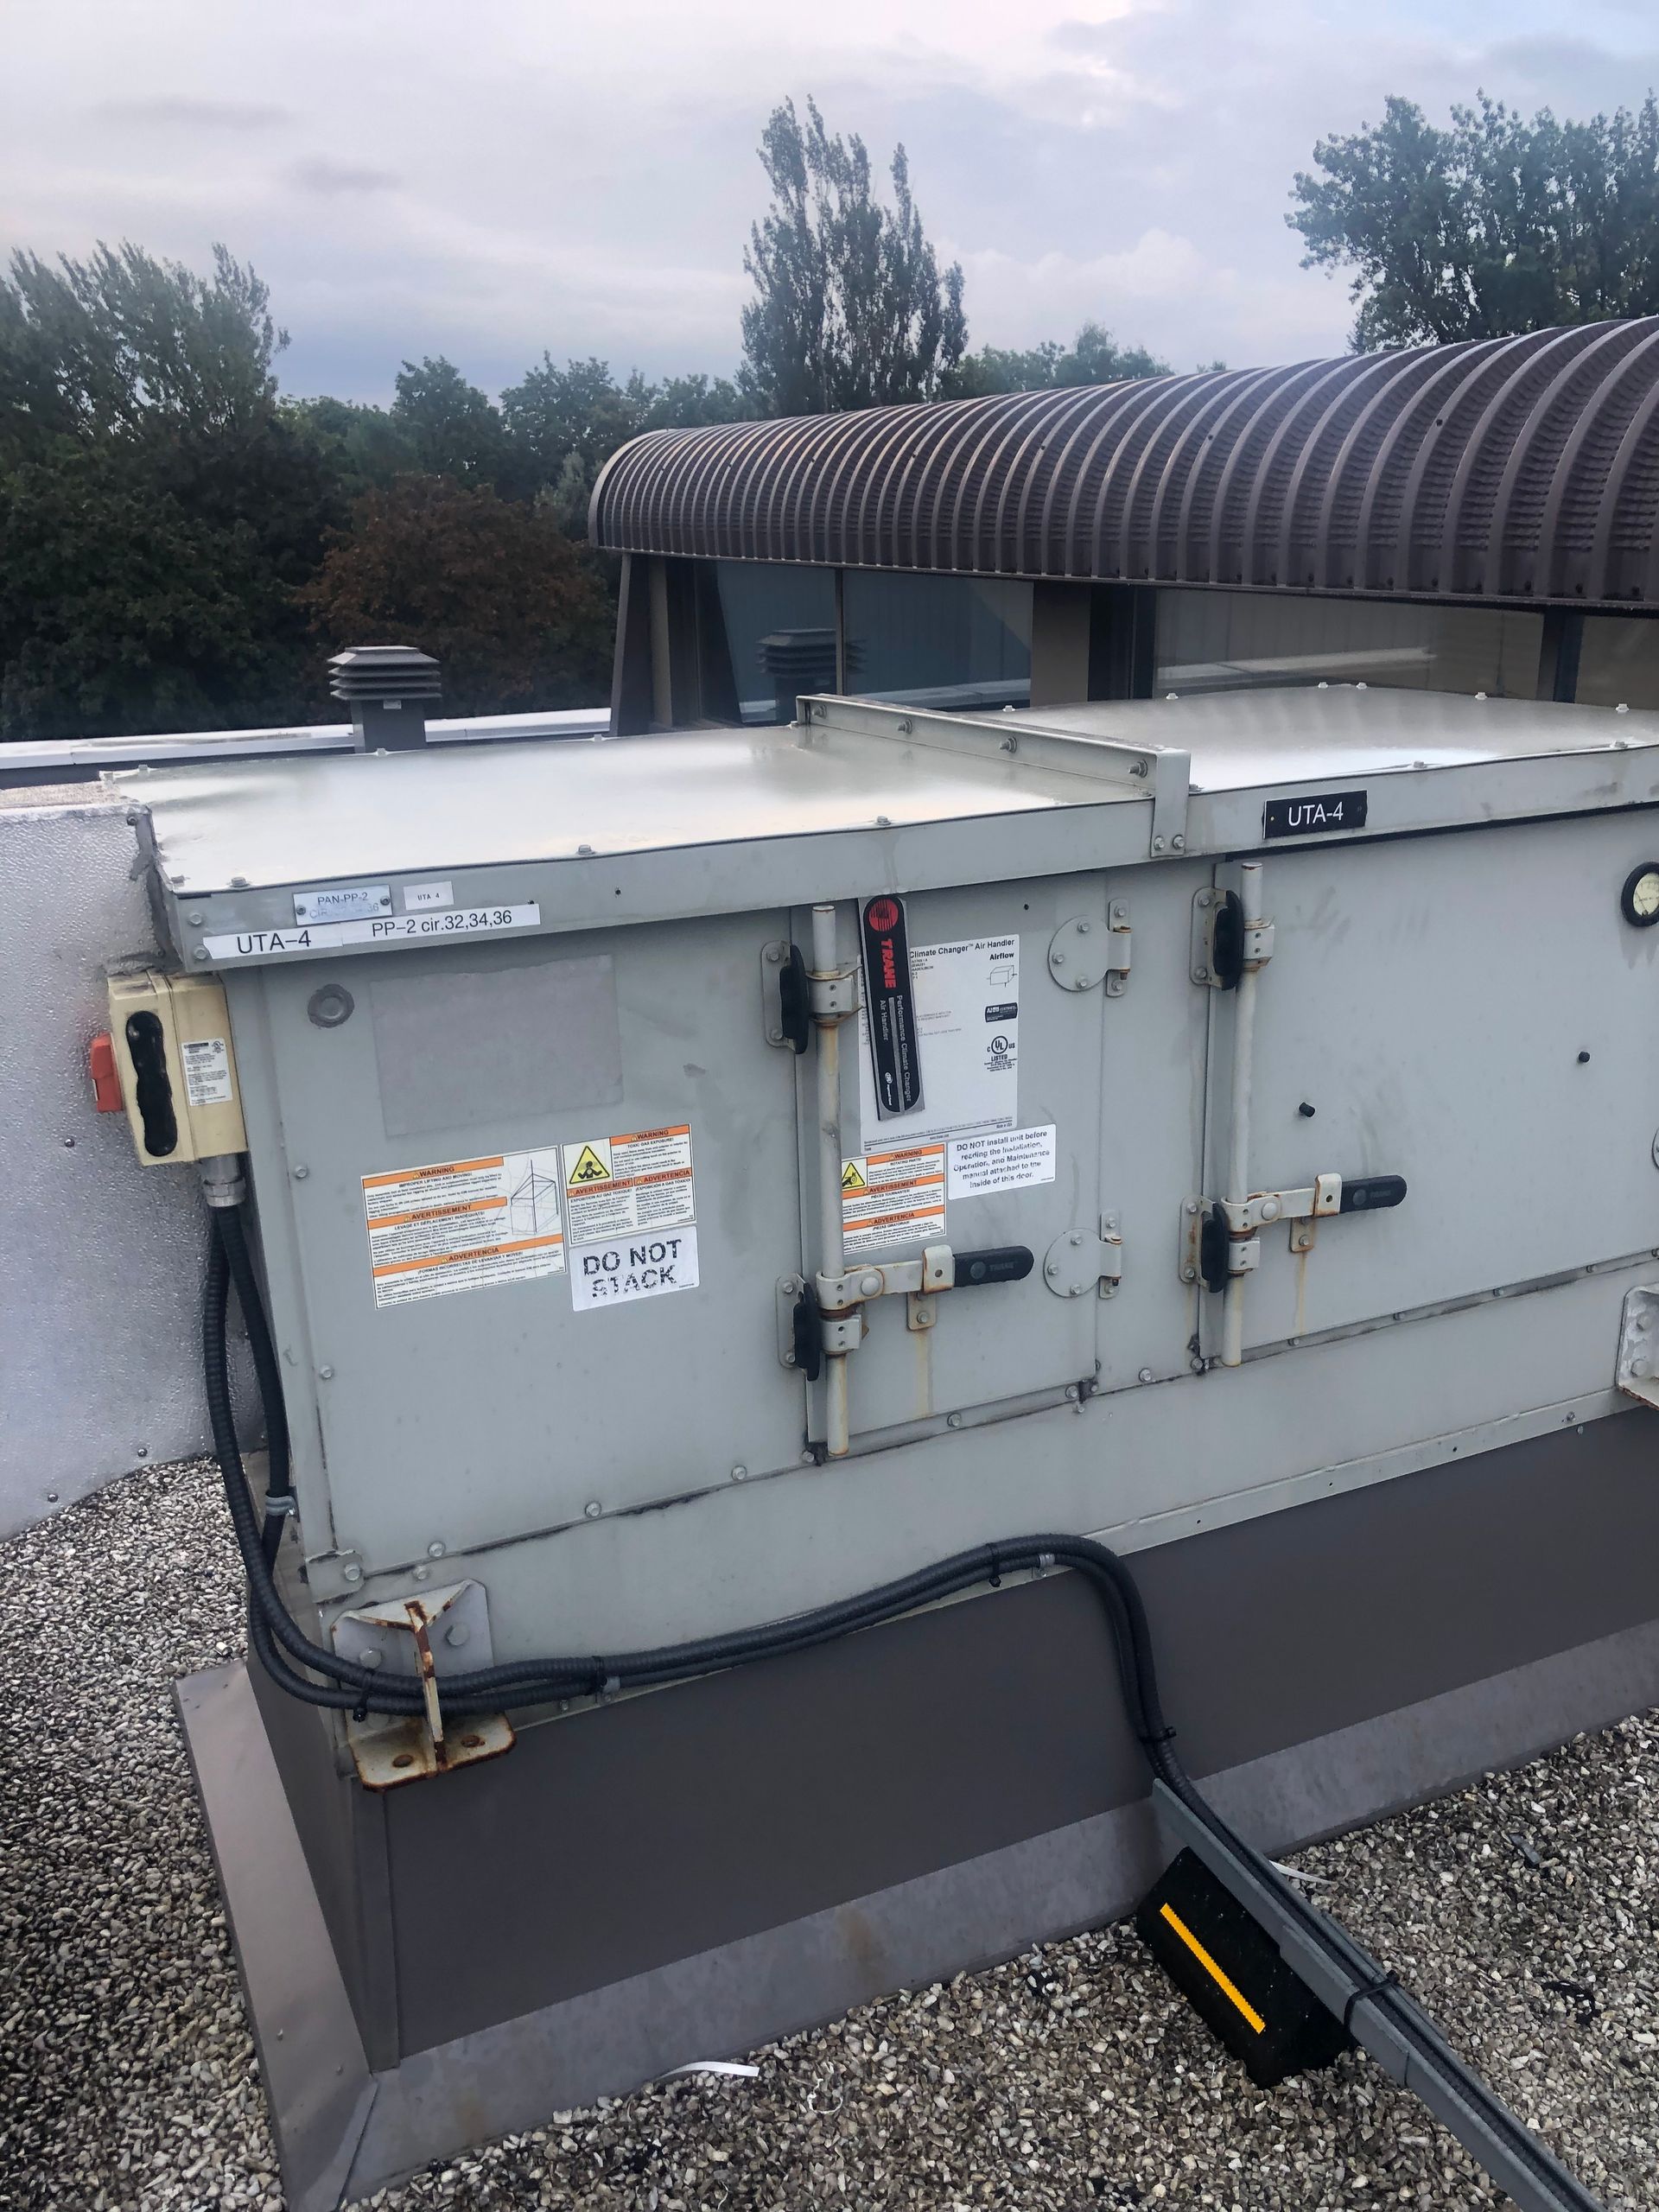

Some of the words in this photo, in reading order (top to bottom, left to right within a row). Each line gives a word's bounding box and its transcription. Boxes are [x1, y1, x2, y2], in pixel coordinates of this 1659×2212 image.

[423, 801, 480, 826] UTA-4
[317, 892, 368, 906] PAN-PP-2
[372, 918, 416, 937] PP-2
[421, 910, 512, 933] cir.32,34,36
[237, 930, 311, 954] UTA-4
[975, 942, 985, 950] Air
[987, 938, 1014, 949] Handler
[881, 938, 897, 988] TRANE
[989, 952, 1014, 961] Airflow
[896, 995, 906, 1042] Performance
[995, 1039, 1004, 1051] UL
[636, 1129, 669, 1140] WARNING
[957, 1143, 968, 1152] DO
[969, 1140, 985, 1149] NOT
[1025, 1131, 1047, 1140] before
[894, 1149, 923, 1159] WARNING
[953, 1160, 990, 1173] Operation,
[1007, 1150, 1050, 1162] Maintenance
[961, 1151, 988, 1161] reading
[419, 1166, 454, 1178] WARNING
[644, 1169, 690, 1183] ADVERTENCIA
[963, 1169, 988, 1180] manual
[989, 1164, 1020, 1175] attached
[575, 1179, 631, 1196] AVERTISSEMENT
[869, 1179, 918, 1192] AVERTISSEMENT
[411, 1205, 472, 1220] AVERTISSEMENT
[874, 1212, 915, 1224] ADVERTENCIA
[448, 1247, 499, 1262] ADVERTENCIA
[582, 1251, 620, 1276] DO
[629, 1238, 682, 1267] NOT
[592, 1264, 677, 1298] STACK
